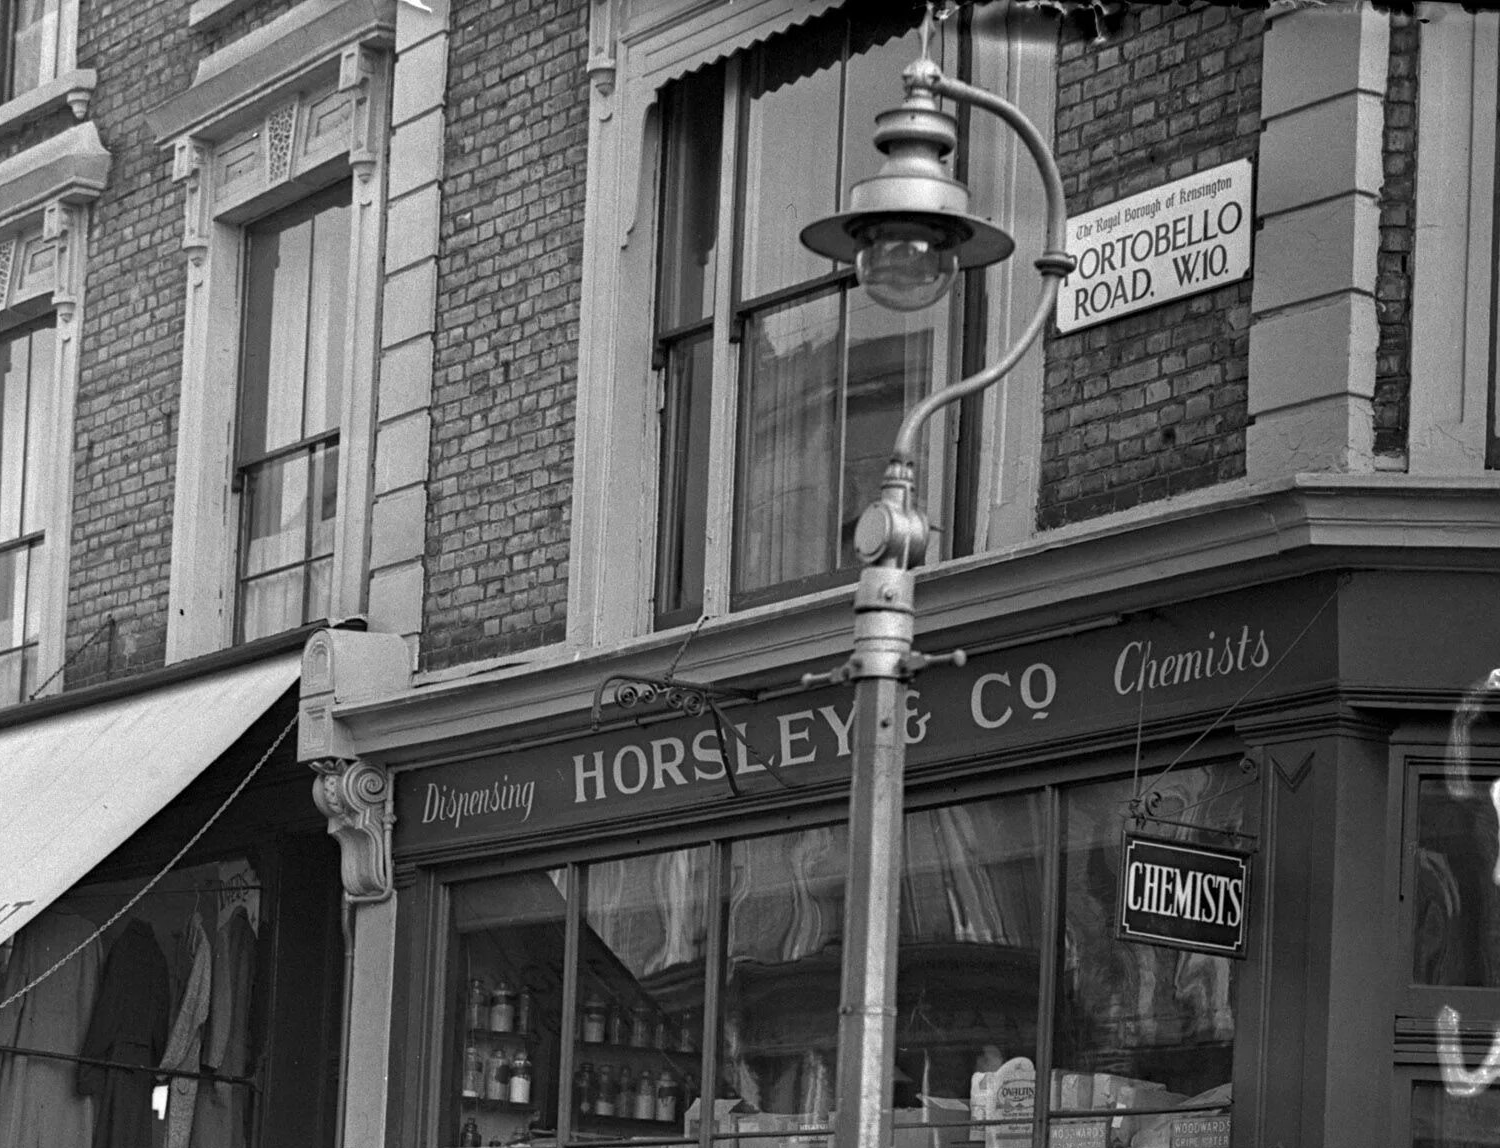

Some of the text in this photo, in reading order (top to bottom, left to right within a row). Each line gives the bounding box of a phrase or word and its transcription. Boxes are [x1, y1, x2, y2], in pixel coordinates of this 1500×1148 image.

[1063, 200, 1243, 288] PORTOBELLO
[1076, 176, 1233, 241] The Royal Borough of Kensington
[422, 775, 536, 829] Dispensing
[572, 700, 856, 804] HORSLEY
[903, 690, 931, 745] &
[1114, 623, 1271, 698] Chemists
[1127, 860, 1243, 929] CHEMISTS
